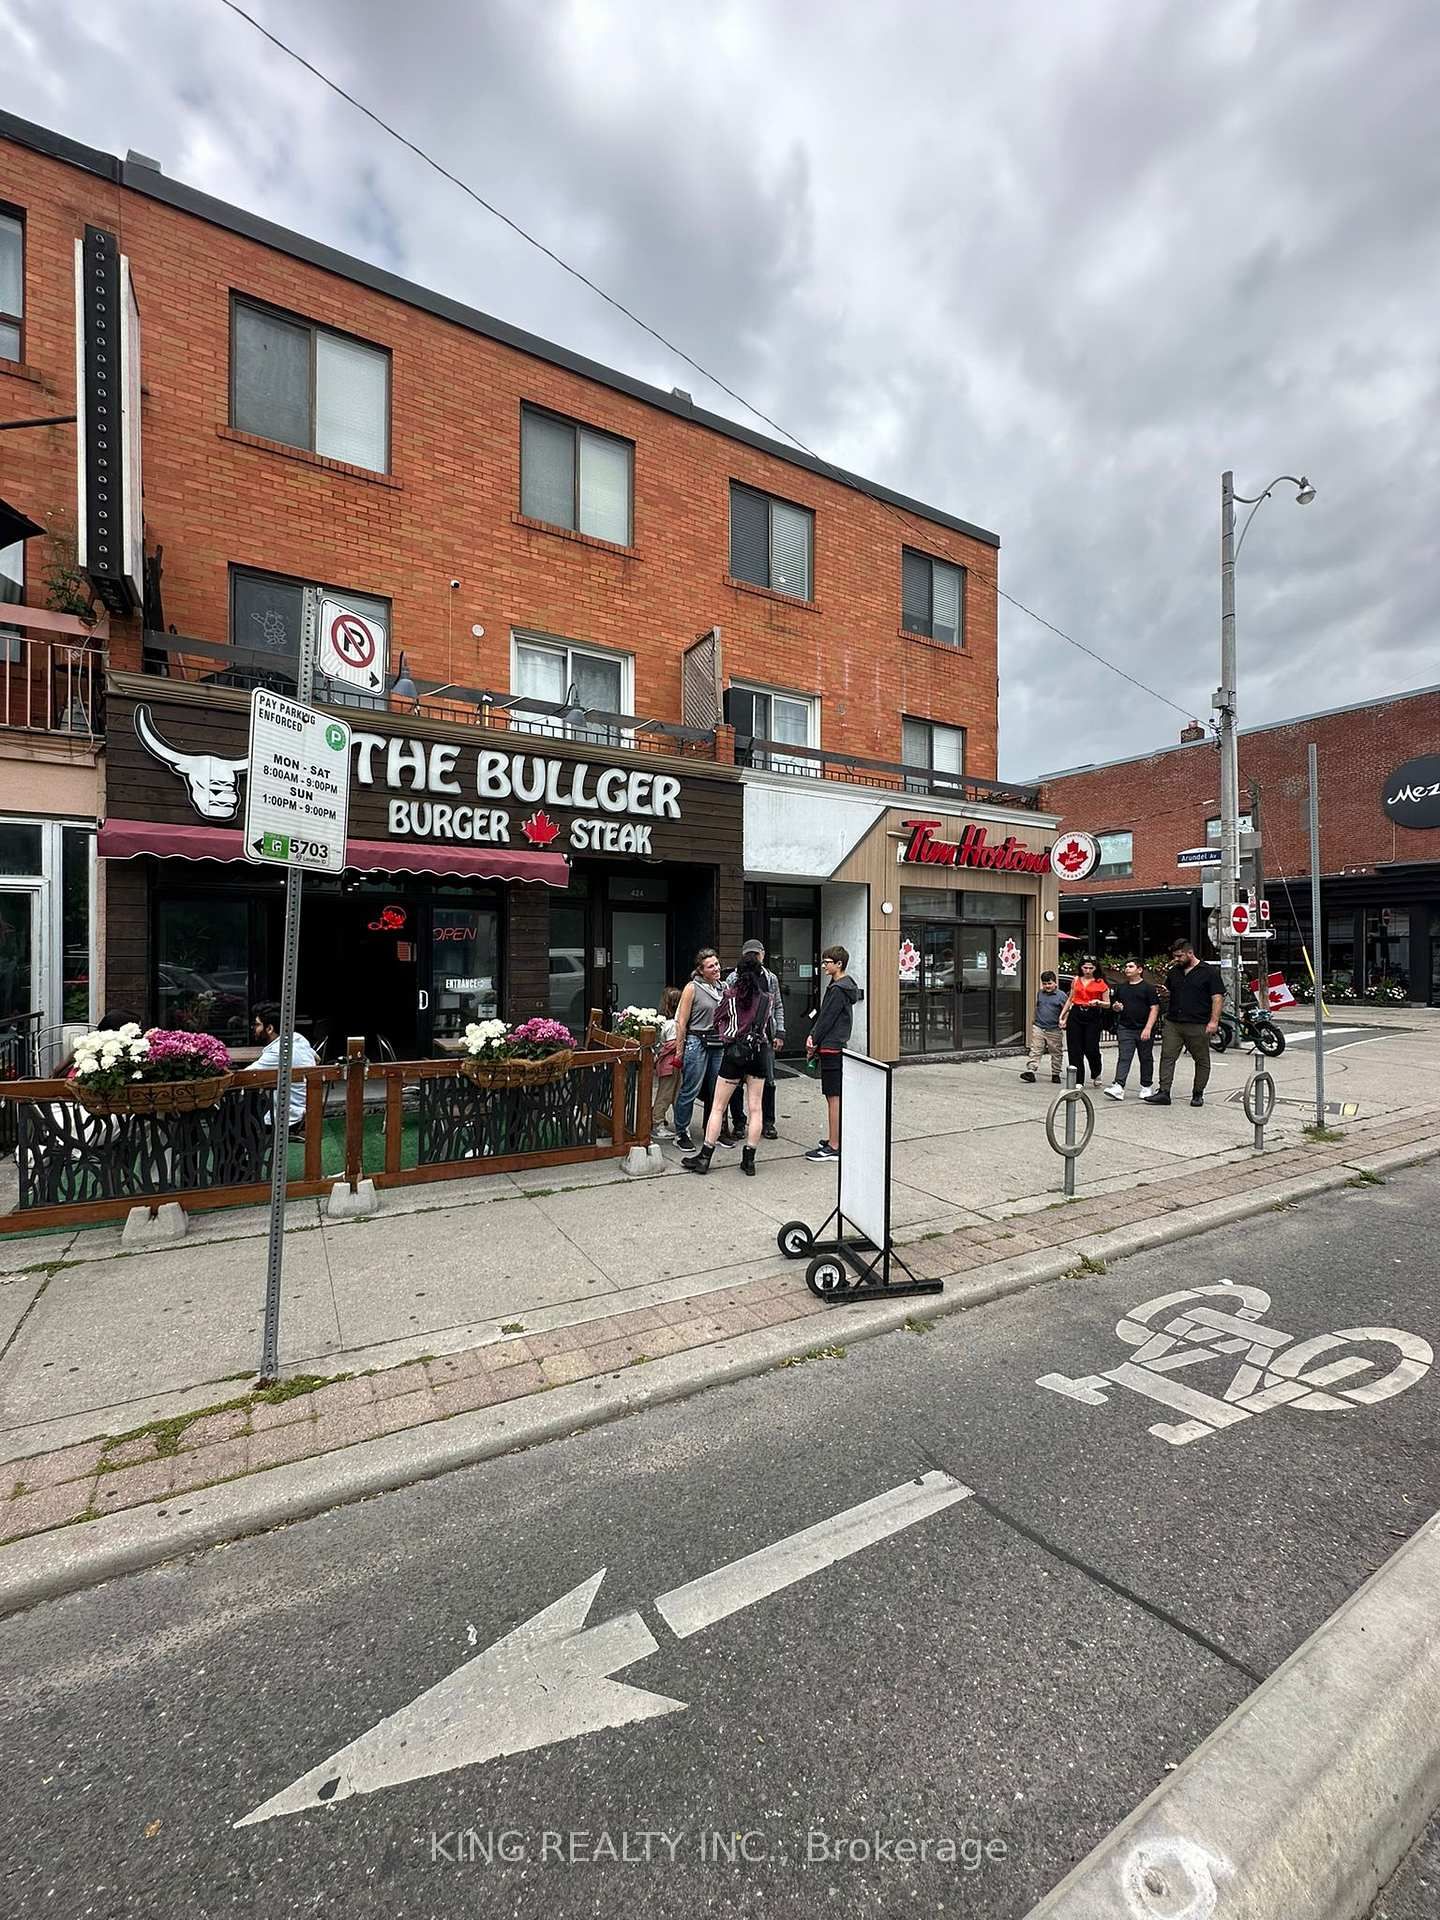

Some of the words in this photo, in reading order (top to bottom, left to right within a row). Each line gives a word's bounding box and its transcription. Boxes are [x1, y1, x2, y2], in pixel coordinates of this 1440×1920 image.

[258, 708, 303, 732] ENFORCED
[259, 695, 278, 710] PAY
[279, 703, 316, 725] PARKING
[273, 753, 300, 771] MON
[310, 765, 331, 779] SAT
[351, 732, 462, 795] THE
[477, 750, 682, 819] BULLGER
[263, 765, 299, 783] 8:00AM
[306, 777, 338, 794] 9:00PM
[262, 793, 297, 811] 1:00PM
[304, 804, 337, 820] 9:00PM
[289, 786, 313, 801] SUN
[388, 799, 511, 843] BURGER
[570, 818, 652, 855] STEAK
[289, 838, 328, 859] 5703
[902, 820, 956, 864] Tim
[954, 823, 1051, 874] Hortons
[1181, 853, 1208, 863] Arundel
[445, 978, 478, 989] ENTRANCE
